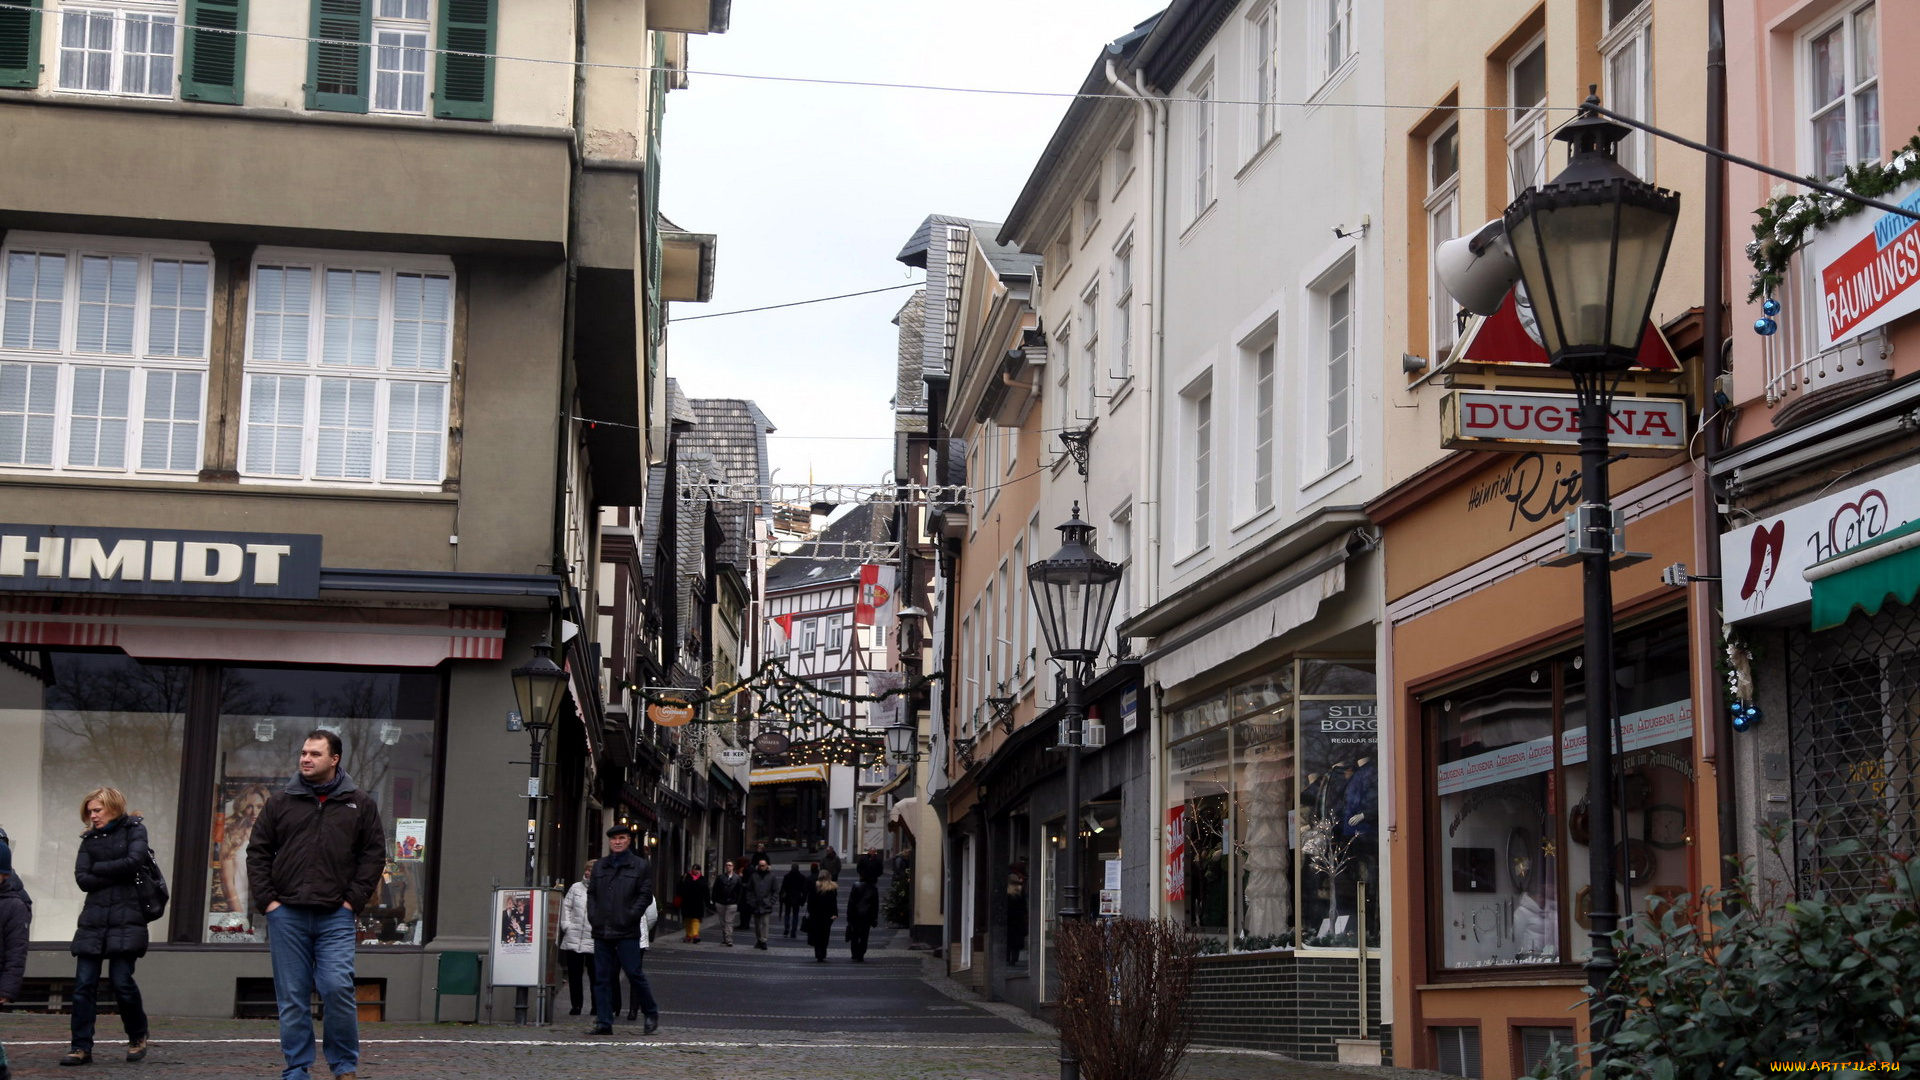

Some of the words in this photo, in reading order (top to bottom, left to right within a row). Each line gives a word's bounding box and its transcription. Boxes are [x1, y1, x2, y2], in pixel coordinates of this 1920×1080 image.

[1468, 467, 1513, 512] Heinrich
[1807, 503, 1882, 563] Herz
[0, 534, 290, 586] HMIDT
[1321, 719, 1377, 731] BORG
[1643, 713, 1675, 731] DUGENA
[1568, 735, 1587, 749] DUGE
[1501, 752, 1525, 765] DUGENA
[1533, 745, 1554, 759] DUGEN
[1471, 760, 1494, 774] DUGENA
